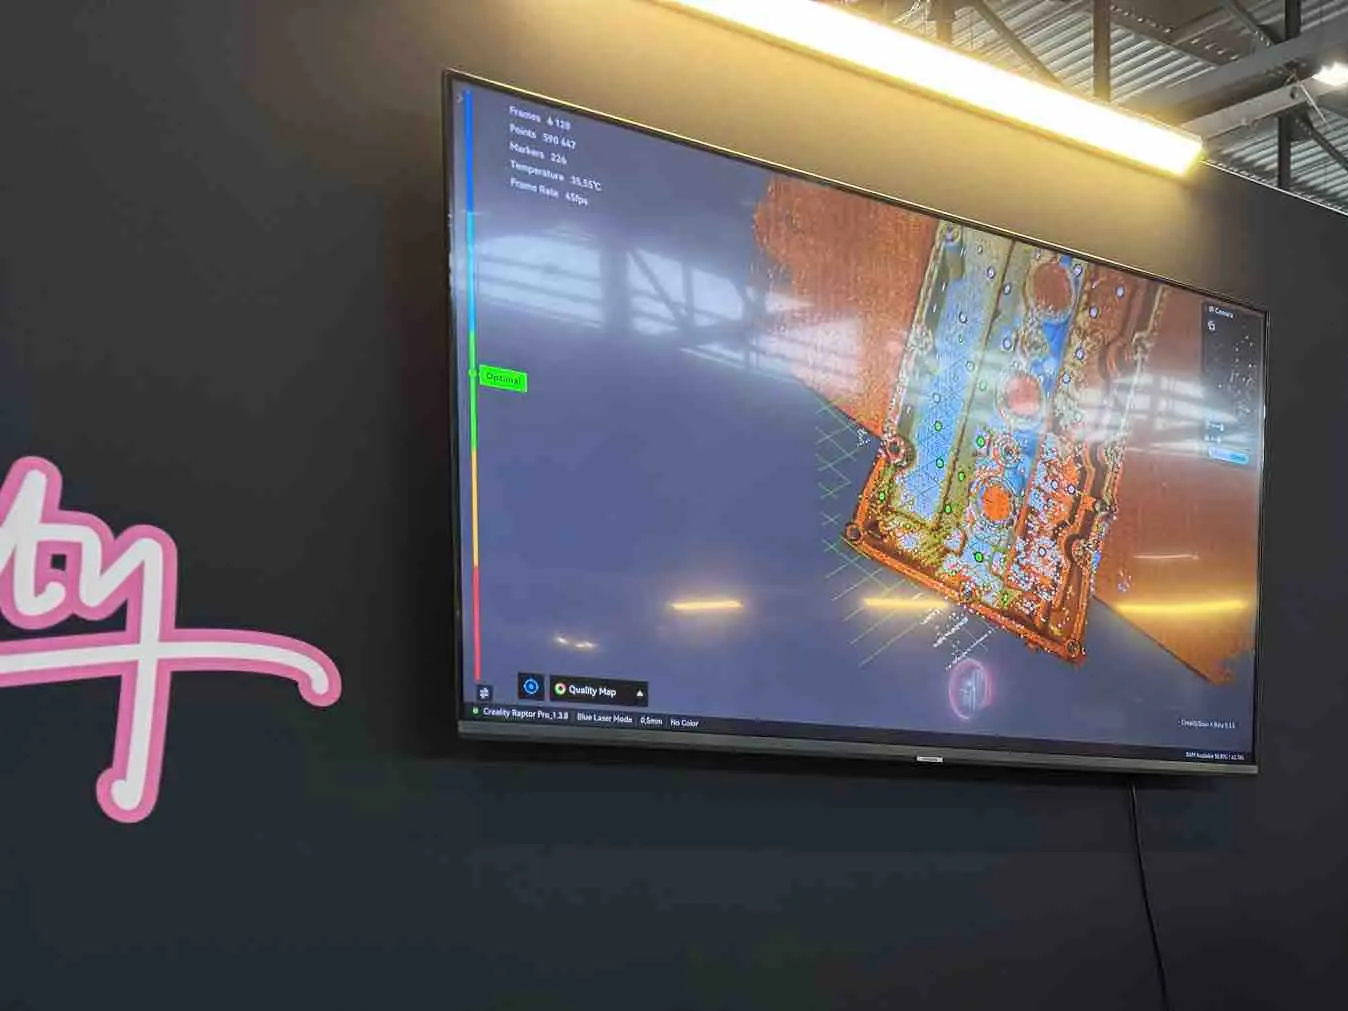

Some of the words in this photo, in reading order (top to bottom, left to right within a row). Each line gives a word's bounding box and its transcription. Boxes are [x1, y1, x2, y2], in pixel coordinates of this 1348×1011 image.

[509, 105, 541, 122] Frames
[509, 123, 537, 139] Points
[510, 142, 545, 159] Markers
[510, 160, 565, 181] Temperature
[510, 177, 538, 192] Frame
[538, 184, 560, 198] Rate
[568, 684, 598, 698] Quality
[598, 686, 617, 699] Map
[483, 706, 511, 719] Creality
[511, 708, 537, 720] Raptor
[577, 712, 592, 721] Blue
[592, 713, 612, 723] Laser
[612, 715, 633, 724] Mode
[670, 717, 681, 727] No
[681, 718, 700, 728] Color
